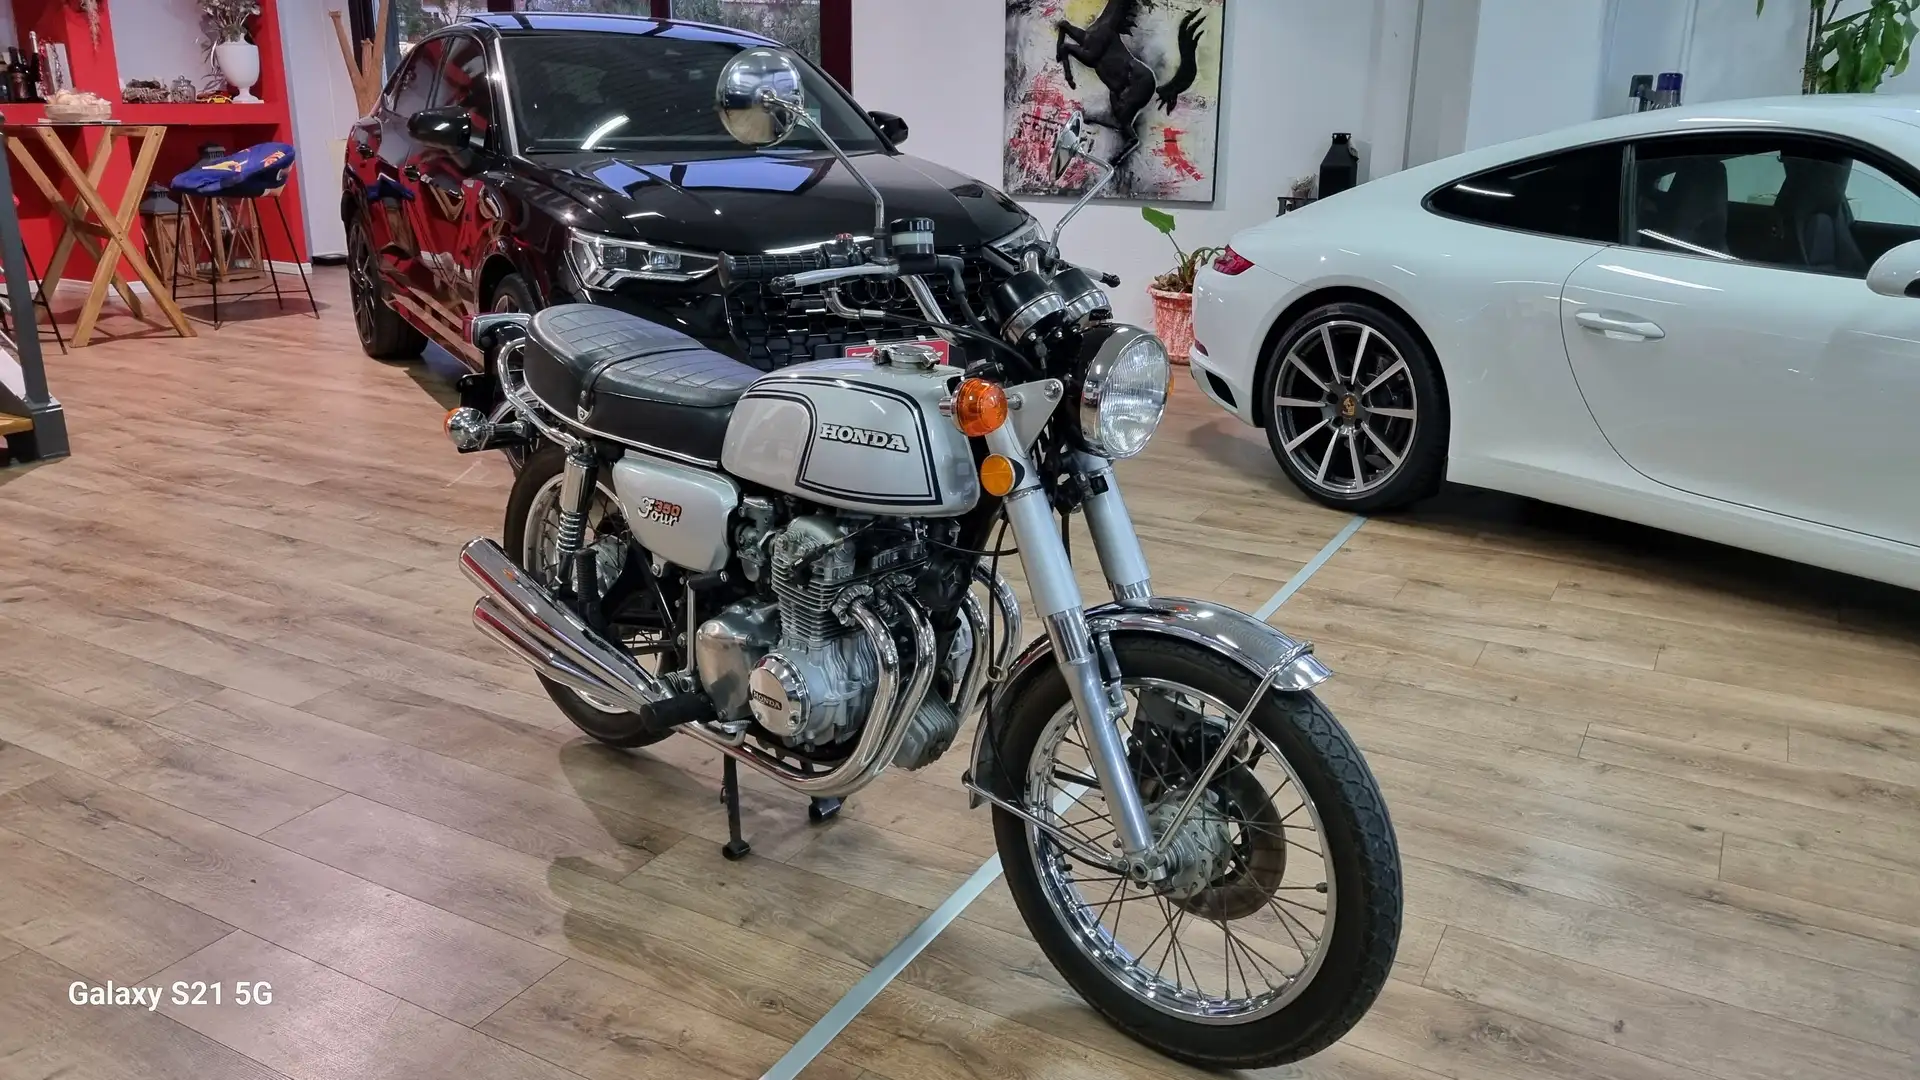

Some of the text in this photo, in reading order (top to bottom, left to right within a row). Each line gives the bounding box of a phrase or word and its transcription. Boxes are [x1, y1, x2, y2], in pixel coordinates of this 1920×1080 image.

[820, 423, 909, 453] HONDA
[638, 497, 679, 526] Four
[753, 690, 781, 710] HONDA
